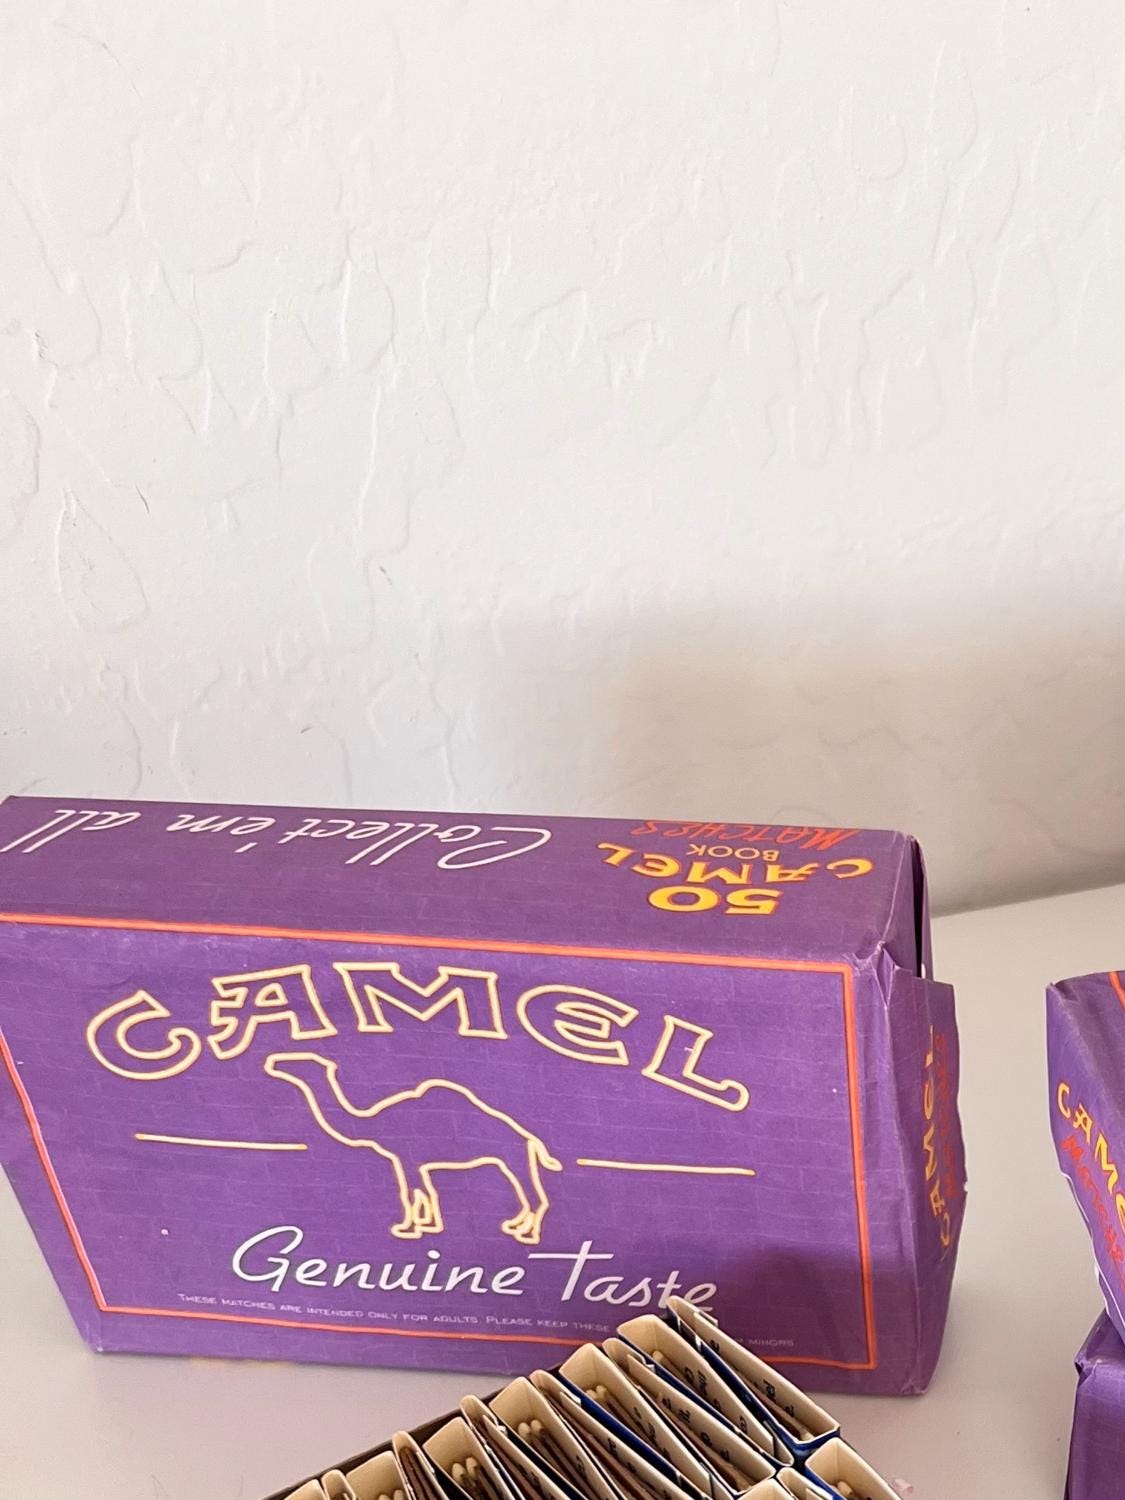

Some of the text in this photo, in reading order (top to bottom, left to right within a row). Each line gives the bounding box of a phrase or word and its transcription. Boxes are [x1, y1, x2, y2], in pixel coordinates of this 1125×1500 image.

[0, 808, 141, 853] all
[278, 817, 552, 869] Collect
[631, 820, 863, 851] MATCHES
[597, 842, 874, 885] CAMEL
[686, 843, 782, 862] BOOK
[647, 885, 785, 916] 50
[86, 961, 750, 1112] CAMEL
[232, 1225, 718, 1312] Genuine Taste
[176, 1293, 216, 1304] THESE
[221, 1298, 277, 1310] MATCHES
[279, 1304, 301, 1314] ARE
[306, 1307, 365, 1318] INTENDED
[367, 1311, 398, 1321] ONLY
[402, 1313, 428, 1322] FOR
[485, 1315, 534, 1328] PLEASE
[536, 1319, 569, 1332] KEEP
